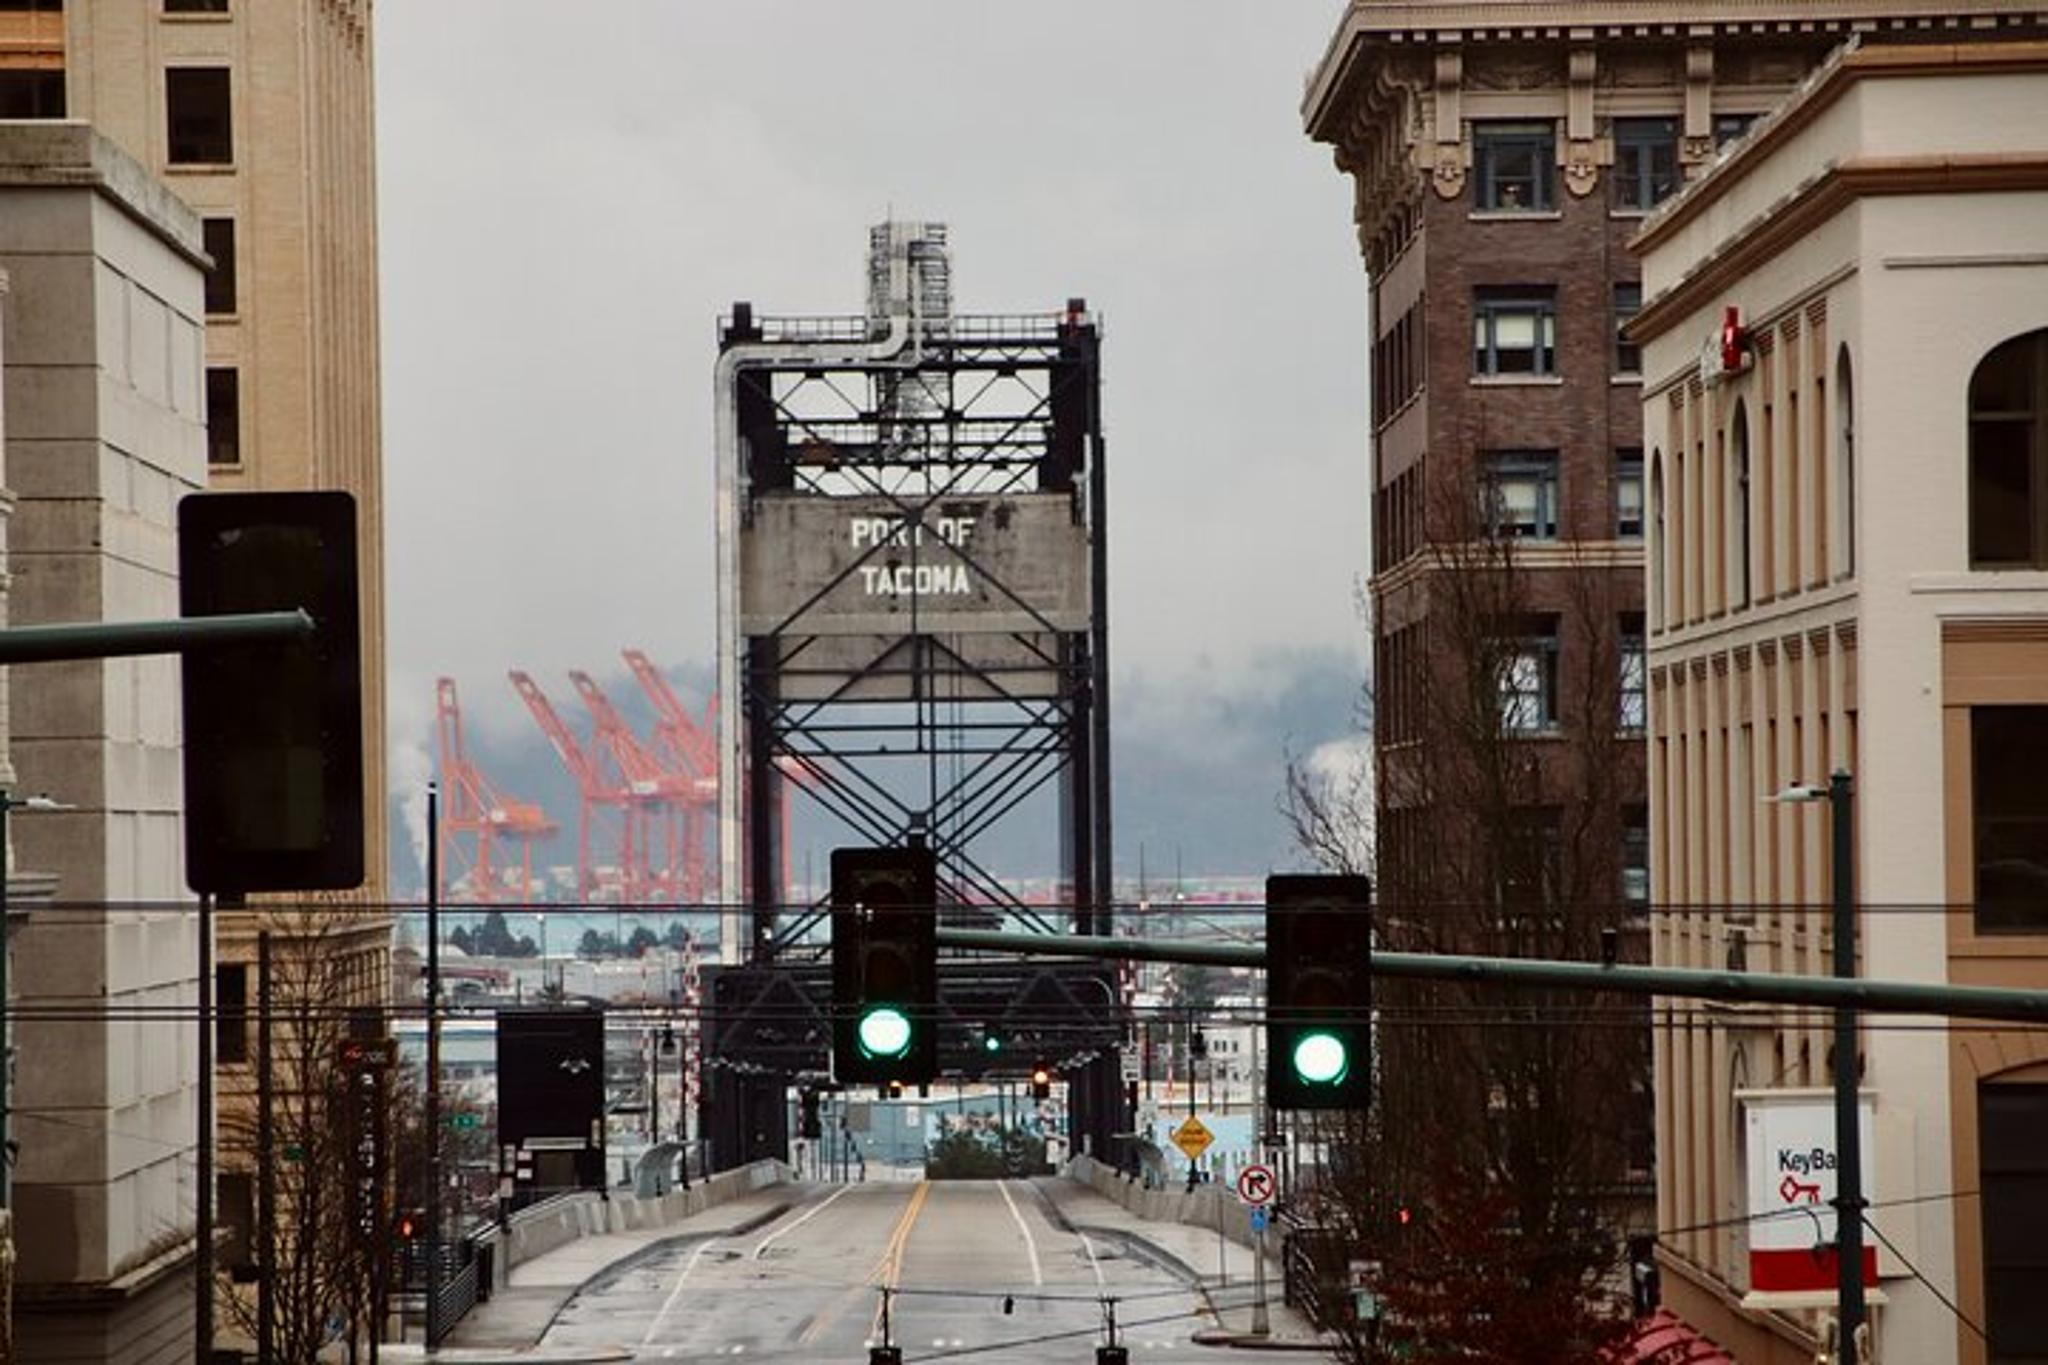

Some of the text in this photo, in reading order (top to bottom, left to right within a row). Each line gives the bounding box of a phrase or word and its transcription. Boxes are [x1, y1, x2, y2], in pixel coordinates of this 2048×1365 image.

[938, 518, 976, 547] OF
[859, 565, 971, 594] TACOMA
[1778, 1148, 1837, 1175] KeyBa
